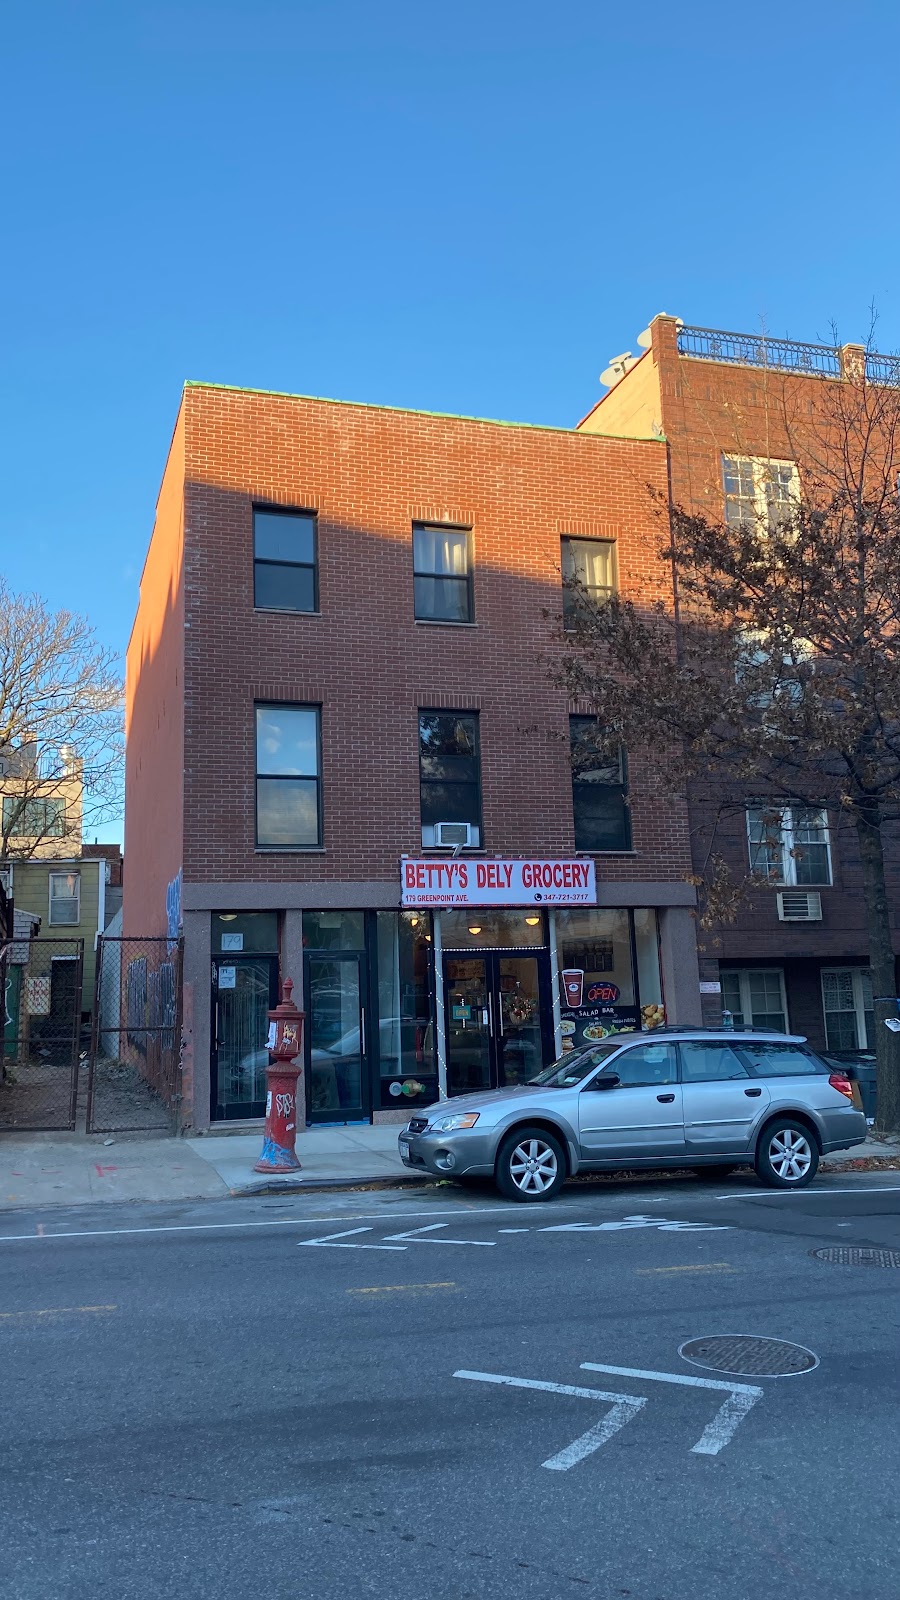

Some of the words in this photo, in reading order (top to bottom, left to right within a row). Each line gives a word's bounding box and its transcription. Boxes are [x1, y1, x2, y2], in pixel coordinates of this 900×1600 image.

[405, 864, 468, 888] BETTY'S
[476, 864, 513, 888] DELY
[521, 863, 590, 888] GROCERY
[417, 894, 455, 902] GREENPOINT
[588, 988, 617, 1001] OPEN
[578, 1009, 599, 1017] SALAD
